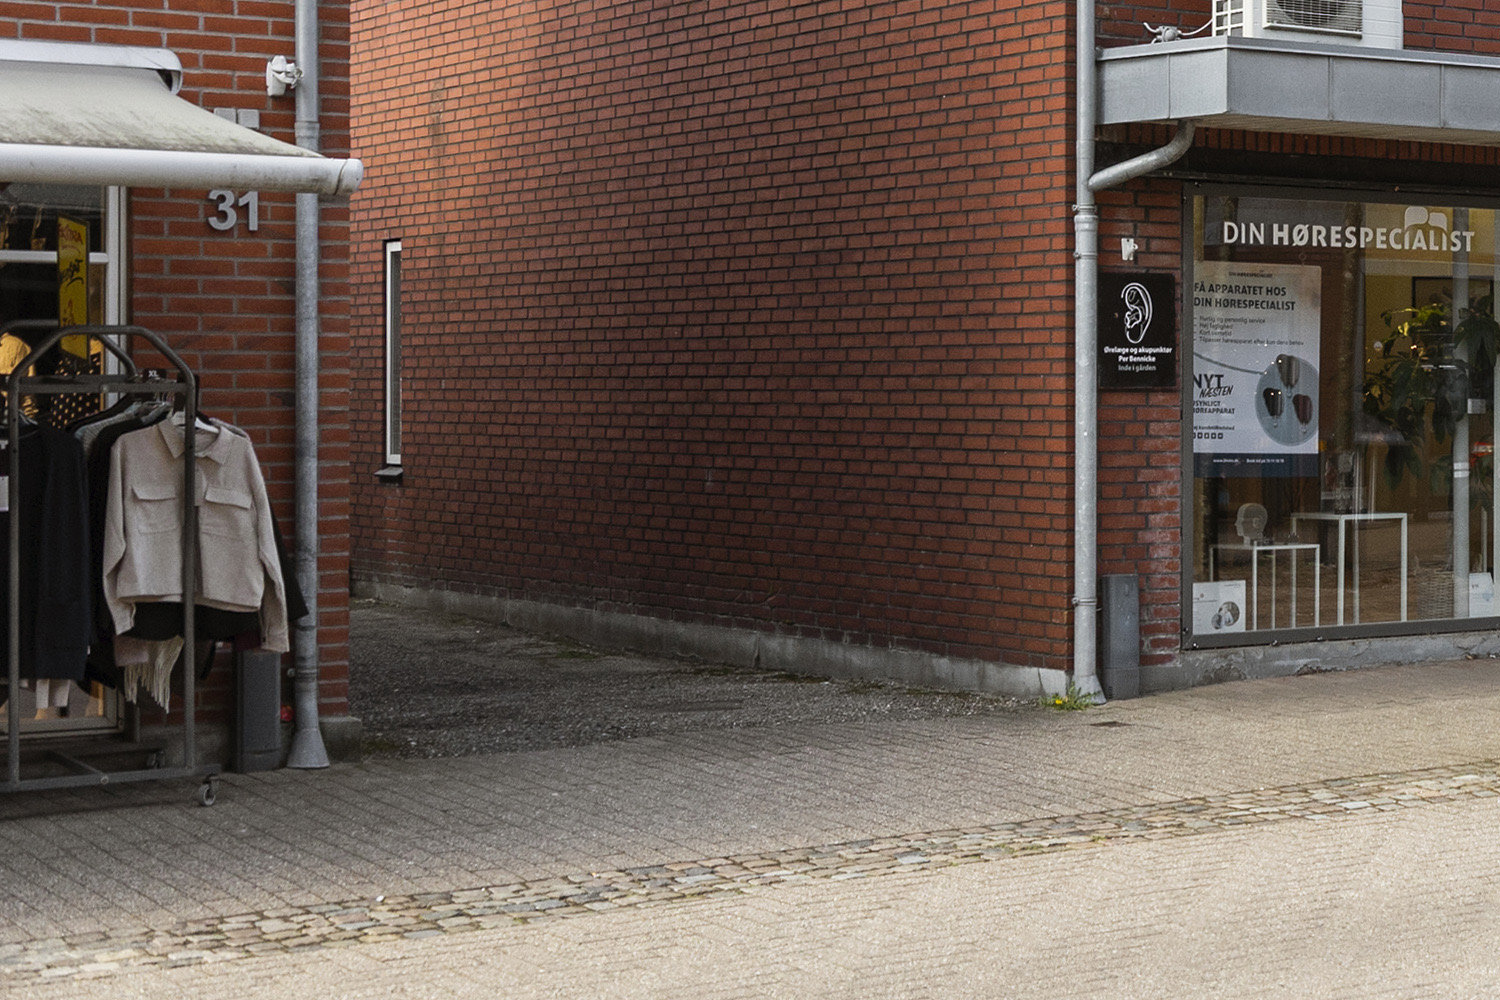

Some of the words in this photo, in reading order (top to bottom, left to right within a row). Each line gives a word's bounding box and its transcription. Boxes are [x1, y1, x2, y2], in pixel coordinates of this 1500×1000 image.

[208, 190, 258, 231] 31
[1223, 221, 1265, 245] DIN
[1272, 223, 1475, 252] HØRESPECIALIST
[1194, 281, 1206, 293] FÅ
[1208, 283, 1263, 296] APPARATET
[1266, 287, 1287, 296] HOS
[1193, 297, 1212, 307] DIN
[1215, 299, 1296, 311] HØRESPECIALIST
[1136, 363, 1157, 372] gården
[1200, 385, 1234, 398] NÆSTEN
